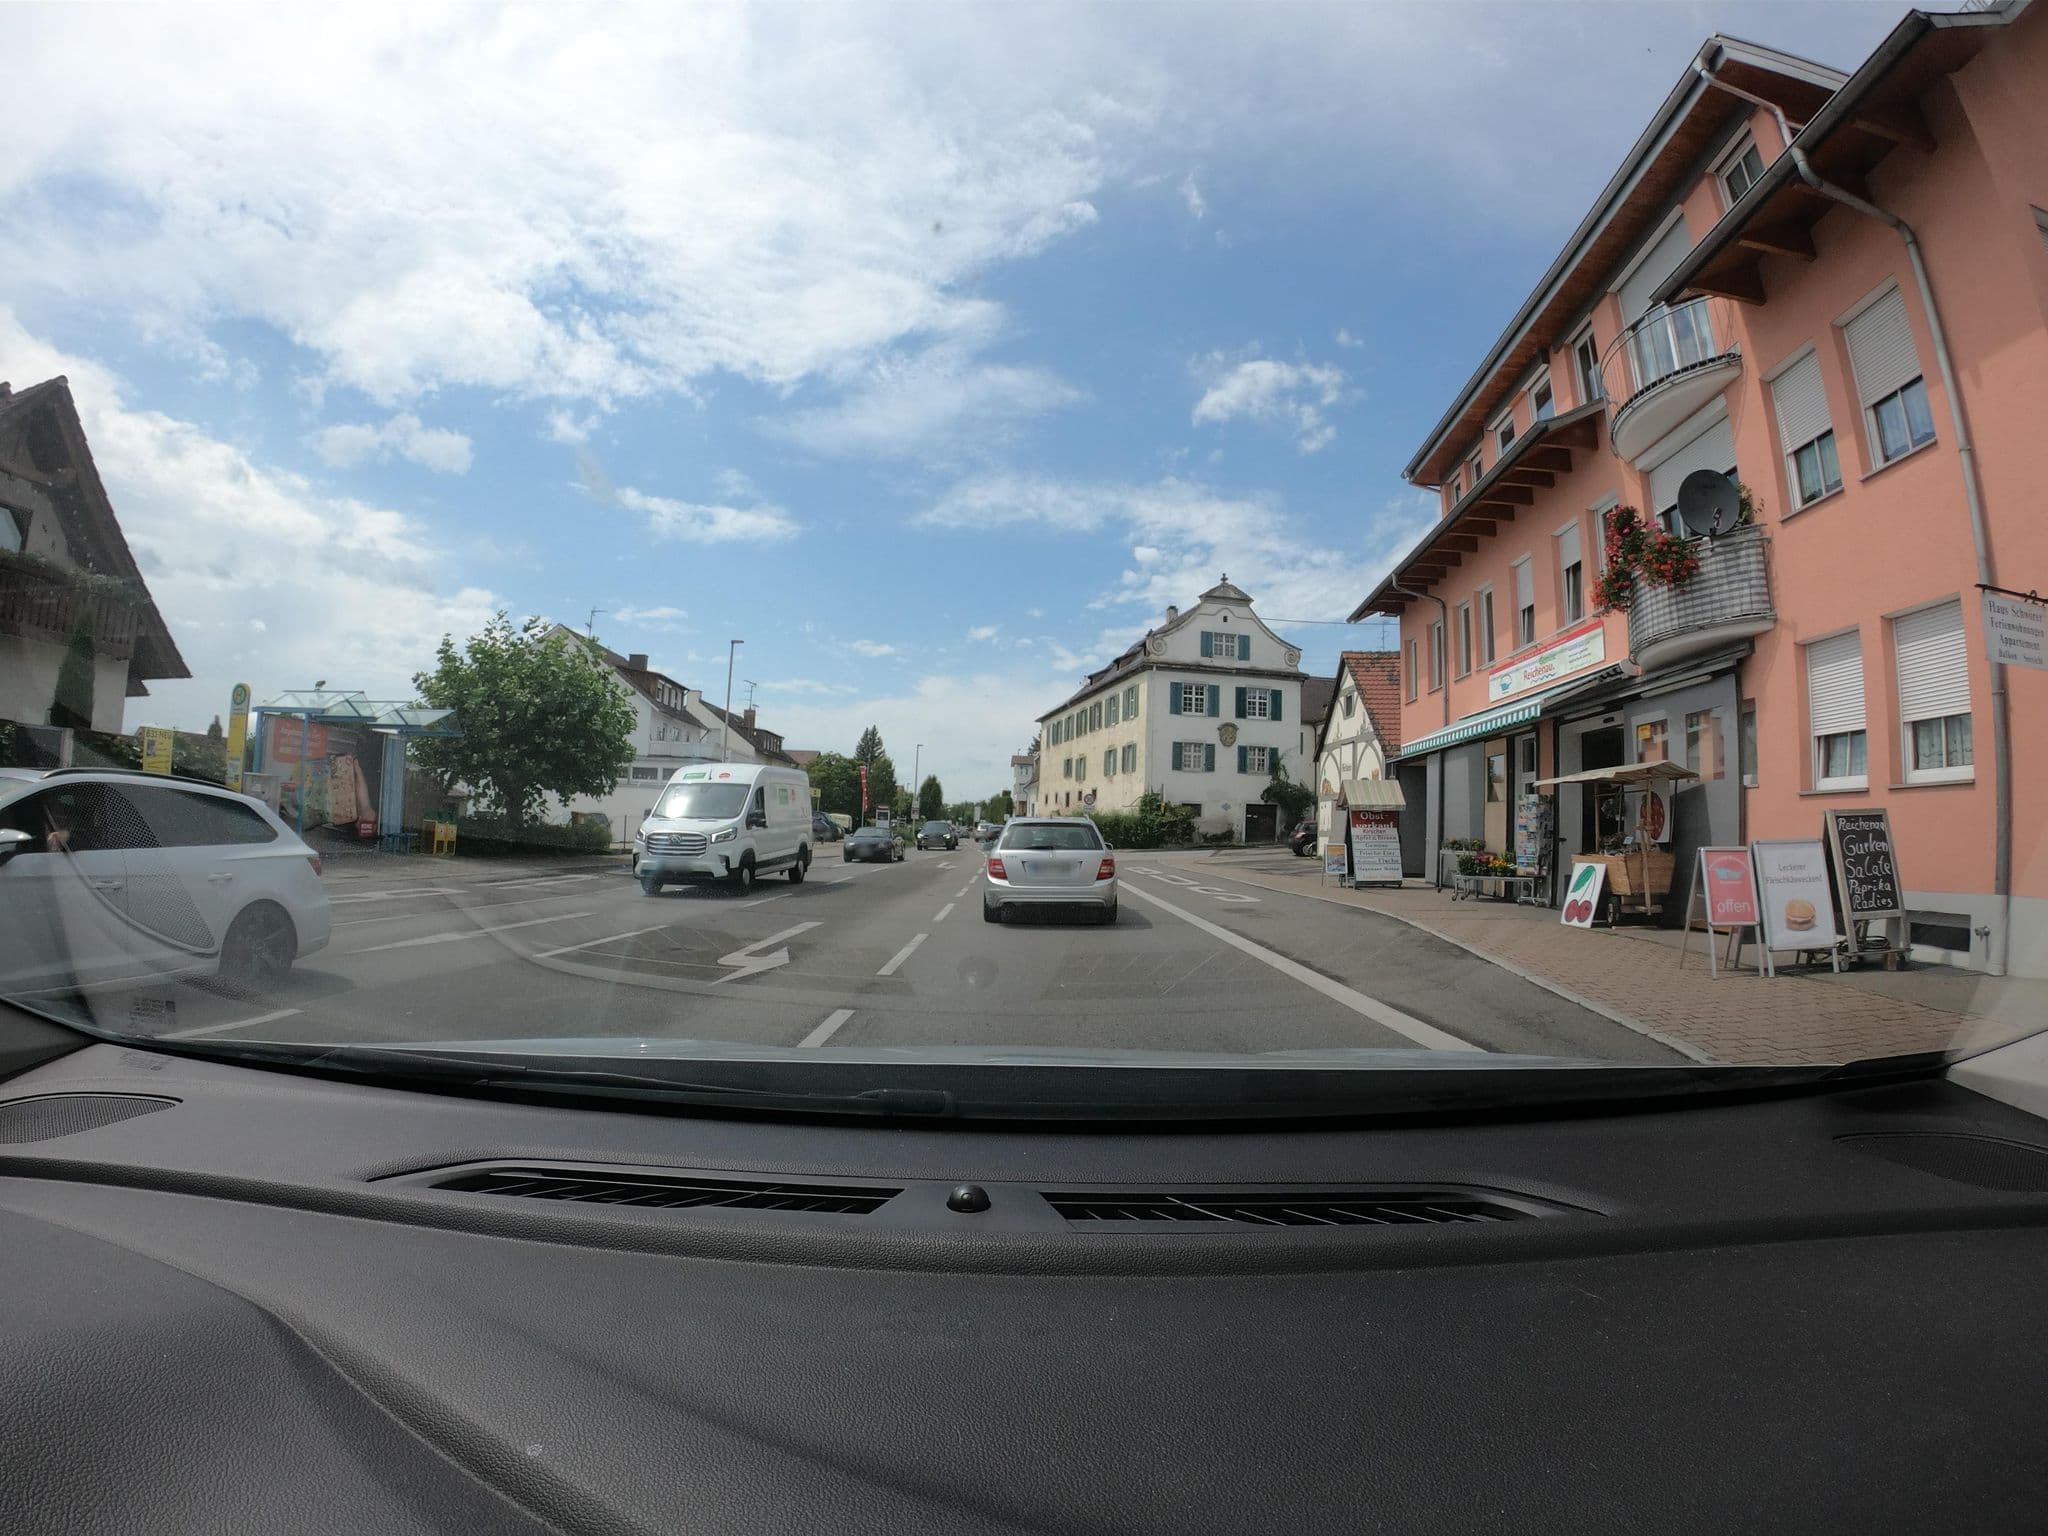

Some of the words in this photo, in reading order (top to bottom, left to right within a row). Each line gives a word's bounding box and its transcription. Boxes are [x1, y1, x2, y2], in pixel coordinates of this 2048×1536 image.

[1989, 600, 2009, 615] Haus
[1843, 833, 1889, 856] Gurken
[1849, 879, 1892, 899] Paprika
[1717, 898, 1750, 913] offen
[1852, 892, 1893, 909] Radies
